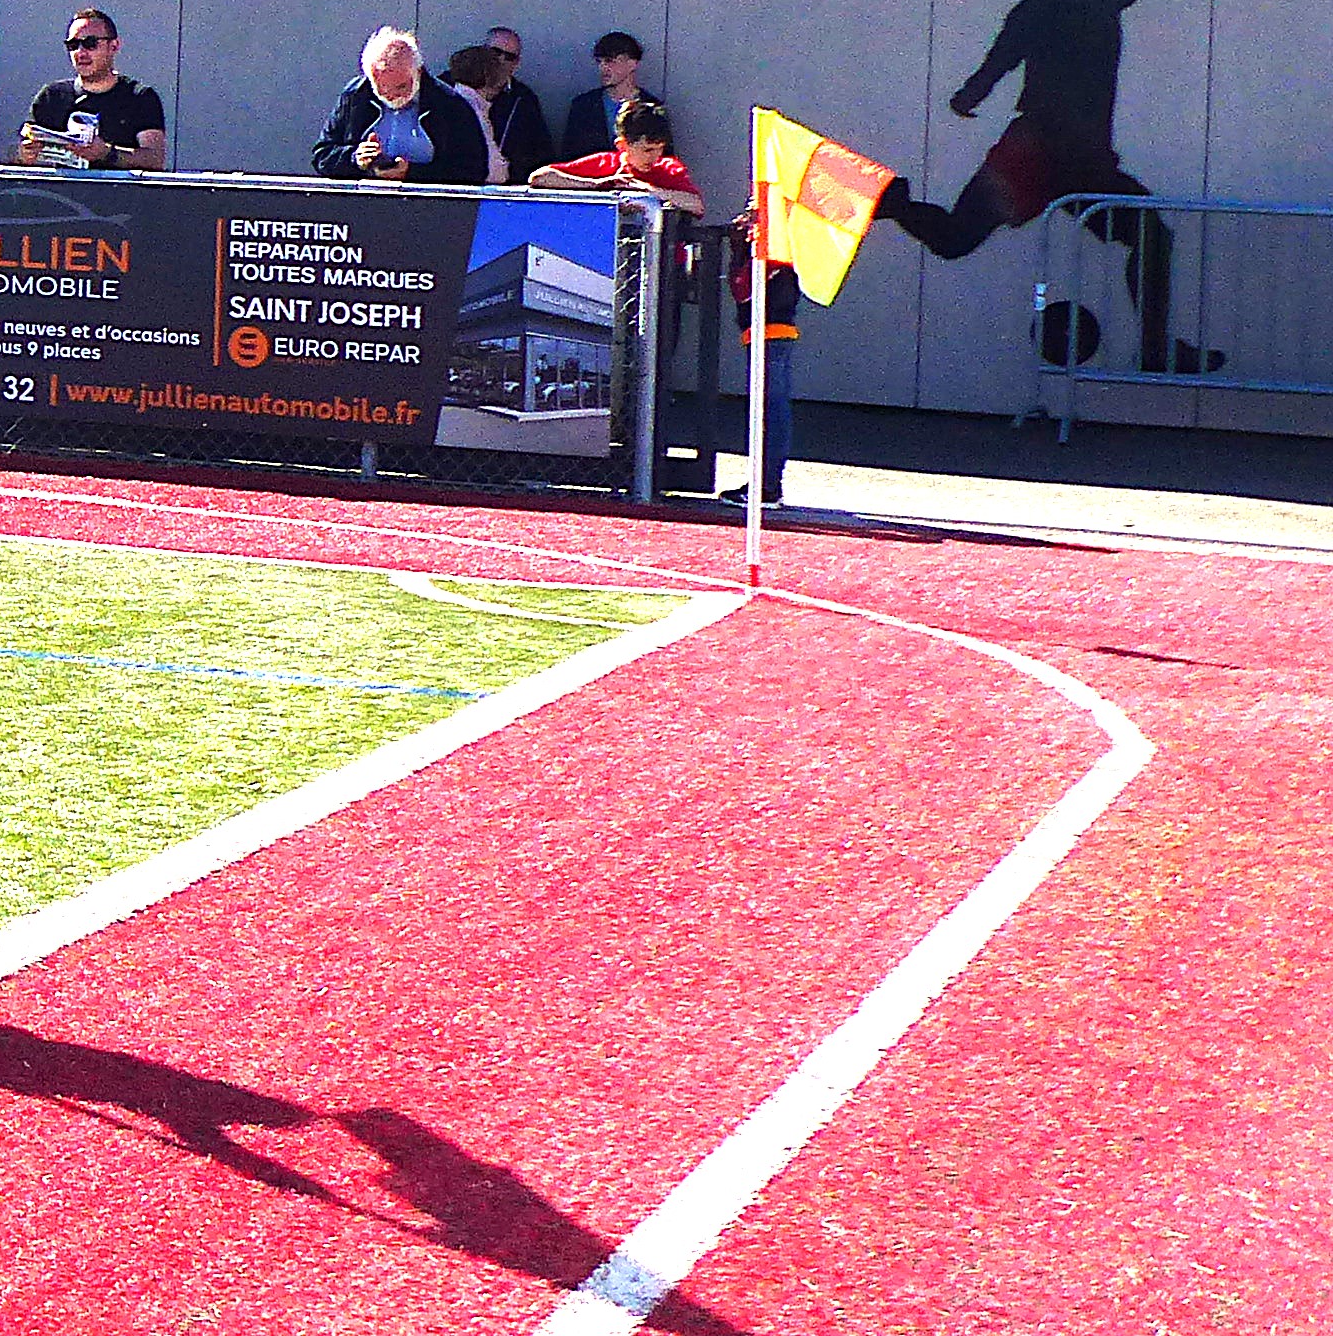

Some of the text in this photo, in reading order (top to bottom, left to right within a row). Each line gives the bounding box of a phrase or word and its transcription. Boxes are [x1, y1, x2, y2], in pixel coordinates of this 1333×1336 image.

[229, 219, 349, 242] ENTRETIEN
[229, 241, 363, 264] REPARATION
[229, 263, 434, 291] TOUTES MARQUES
[228, 295, 423, 330] SAINT JOSEPH
[3, 321, 67, 338] neuves
[71, 324, 91, 340] et
[94, 324, 201, 346] d'occasions
[27, 341, 39, 357] 9
[43, 342, 102, 361] places
[274, 337, 421, 364] EURO REPAR
[2, 375, 35, 403] 32
[65, 382, 423, 426] www.jullienautomobile.fr
